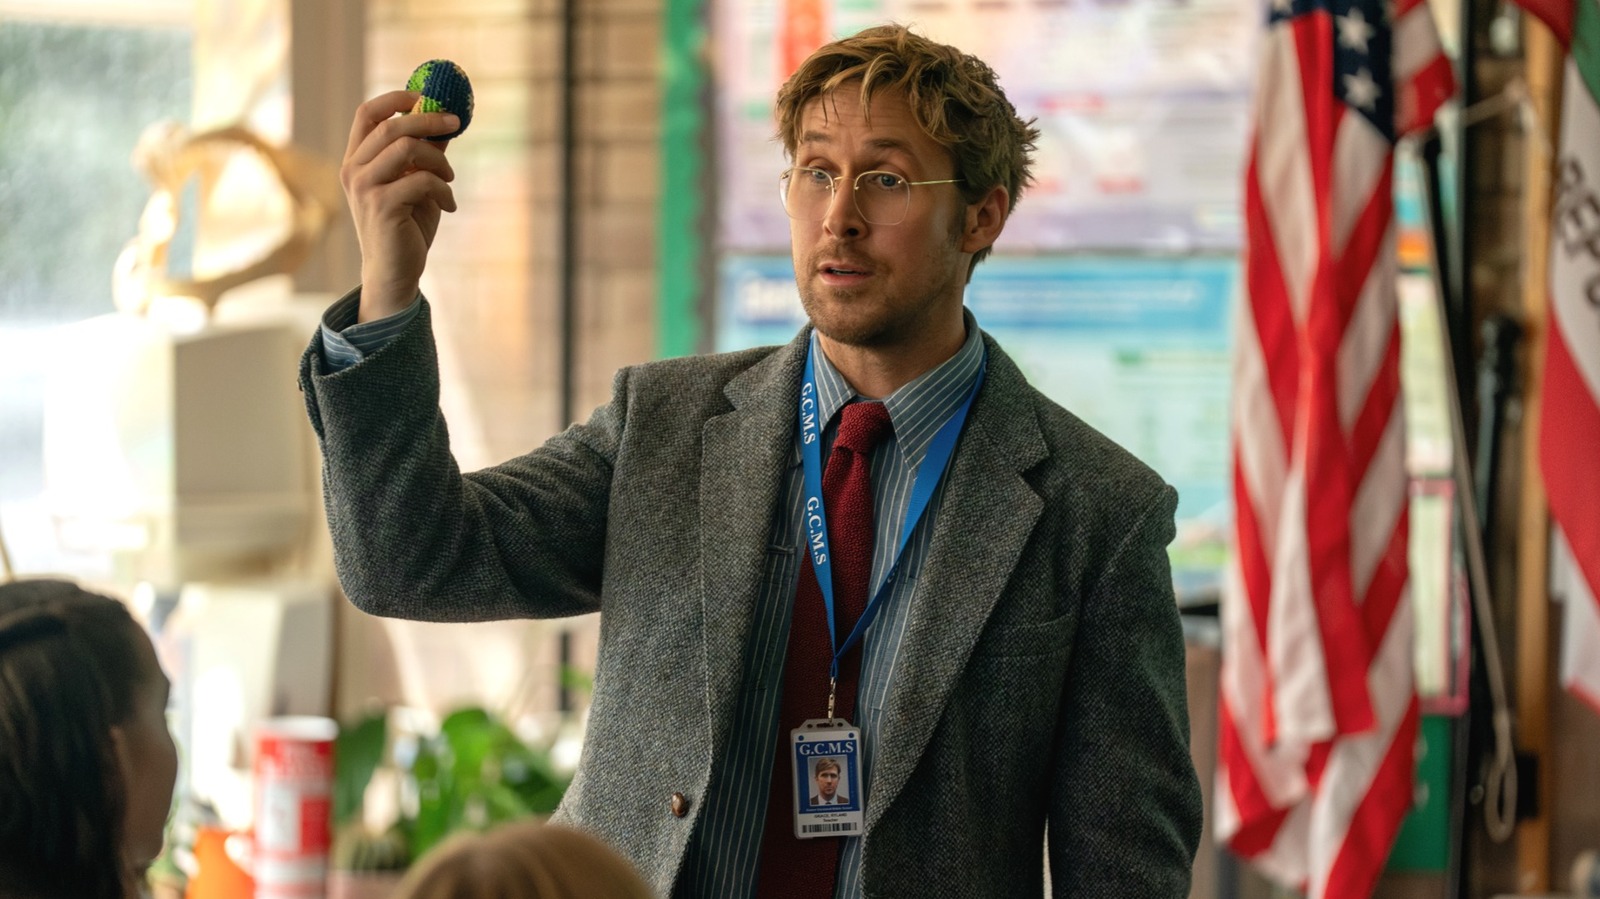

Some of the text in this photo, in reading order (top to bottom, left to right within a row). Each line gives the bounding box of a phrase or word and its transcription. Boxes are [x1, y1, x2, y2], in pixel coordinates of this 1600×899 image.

[802, 382, 816, 445] G.C.M.S
[807, 496, 827, 566] G.C.M.S
[799, 741, 854, 756] G.C.M.S
